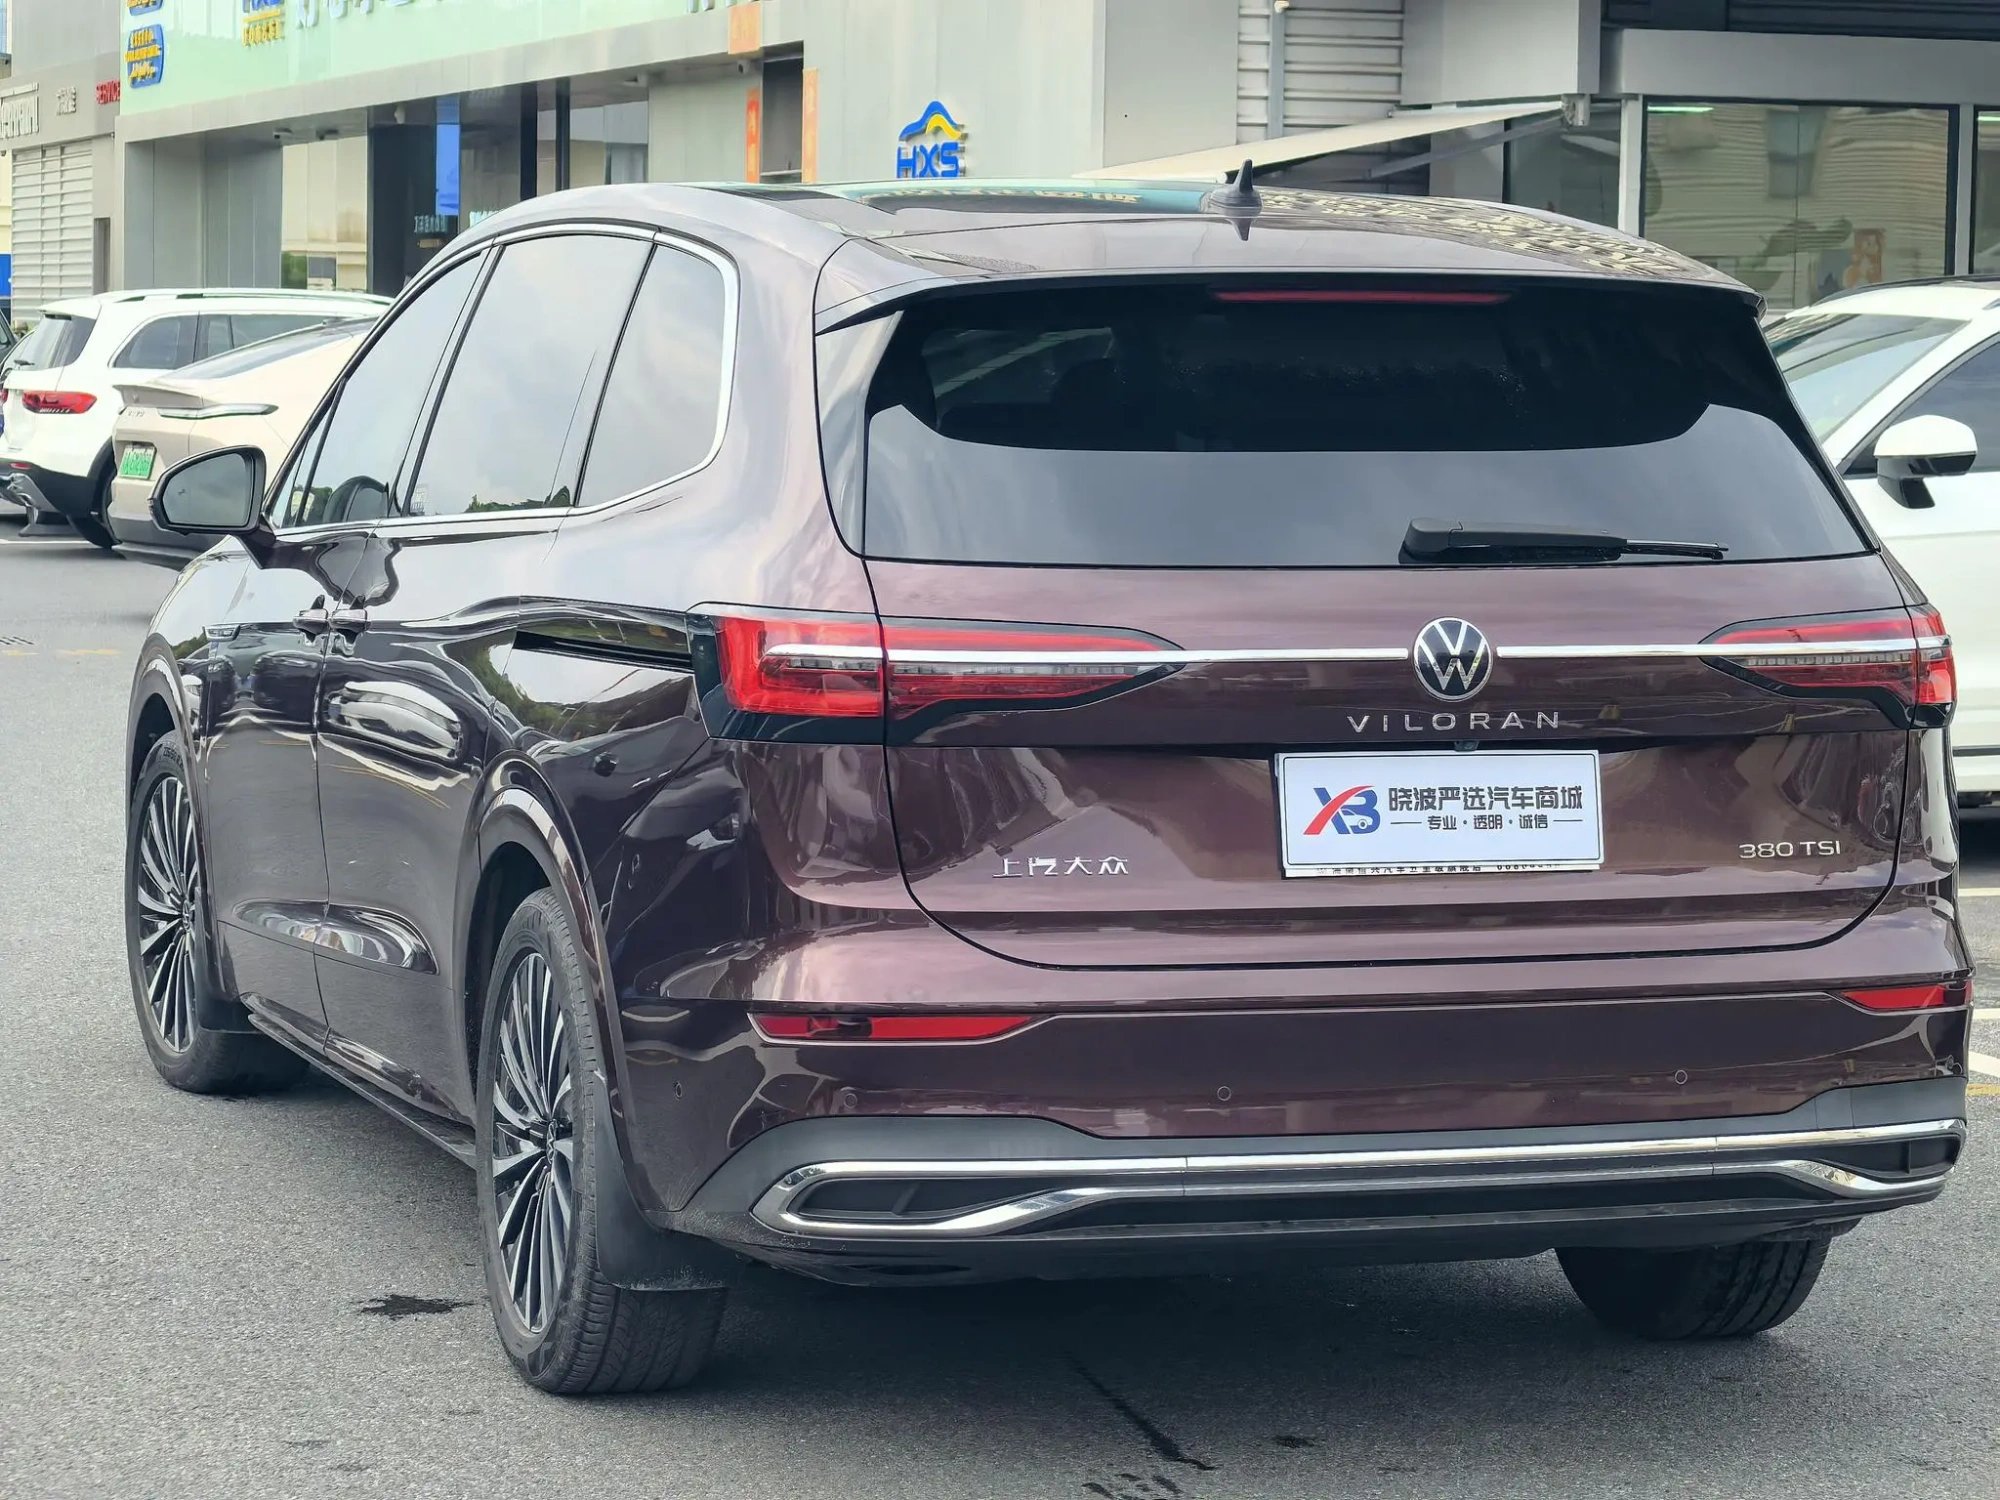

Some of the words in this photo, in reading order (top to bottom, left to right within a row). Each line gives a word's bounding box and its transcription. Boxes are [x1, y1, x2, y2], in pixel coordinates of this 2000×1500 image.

[896, 141, 959, 178] HXS
[1347, 711, 1560, 733] VILORAN
[1388, 785, 1583, 812] 晓波严选汽车商城
[1739, 842, 1794, 859] 380
[1800, 840, 1841, 856] TSI
[992, 856, 1129, 878] 上汽大众
